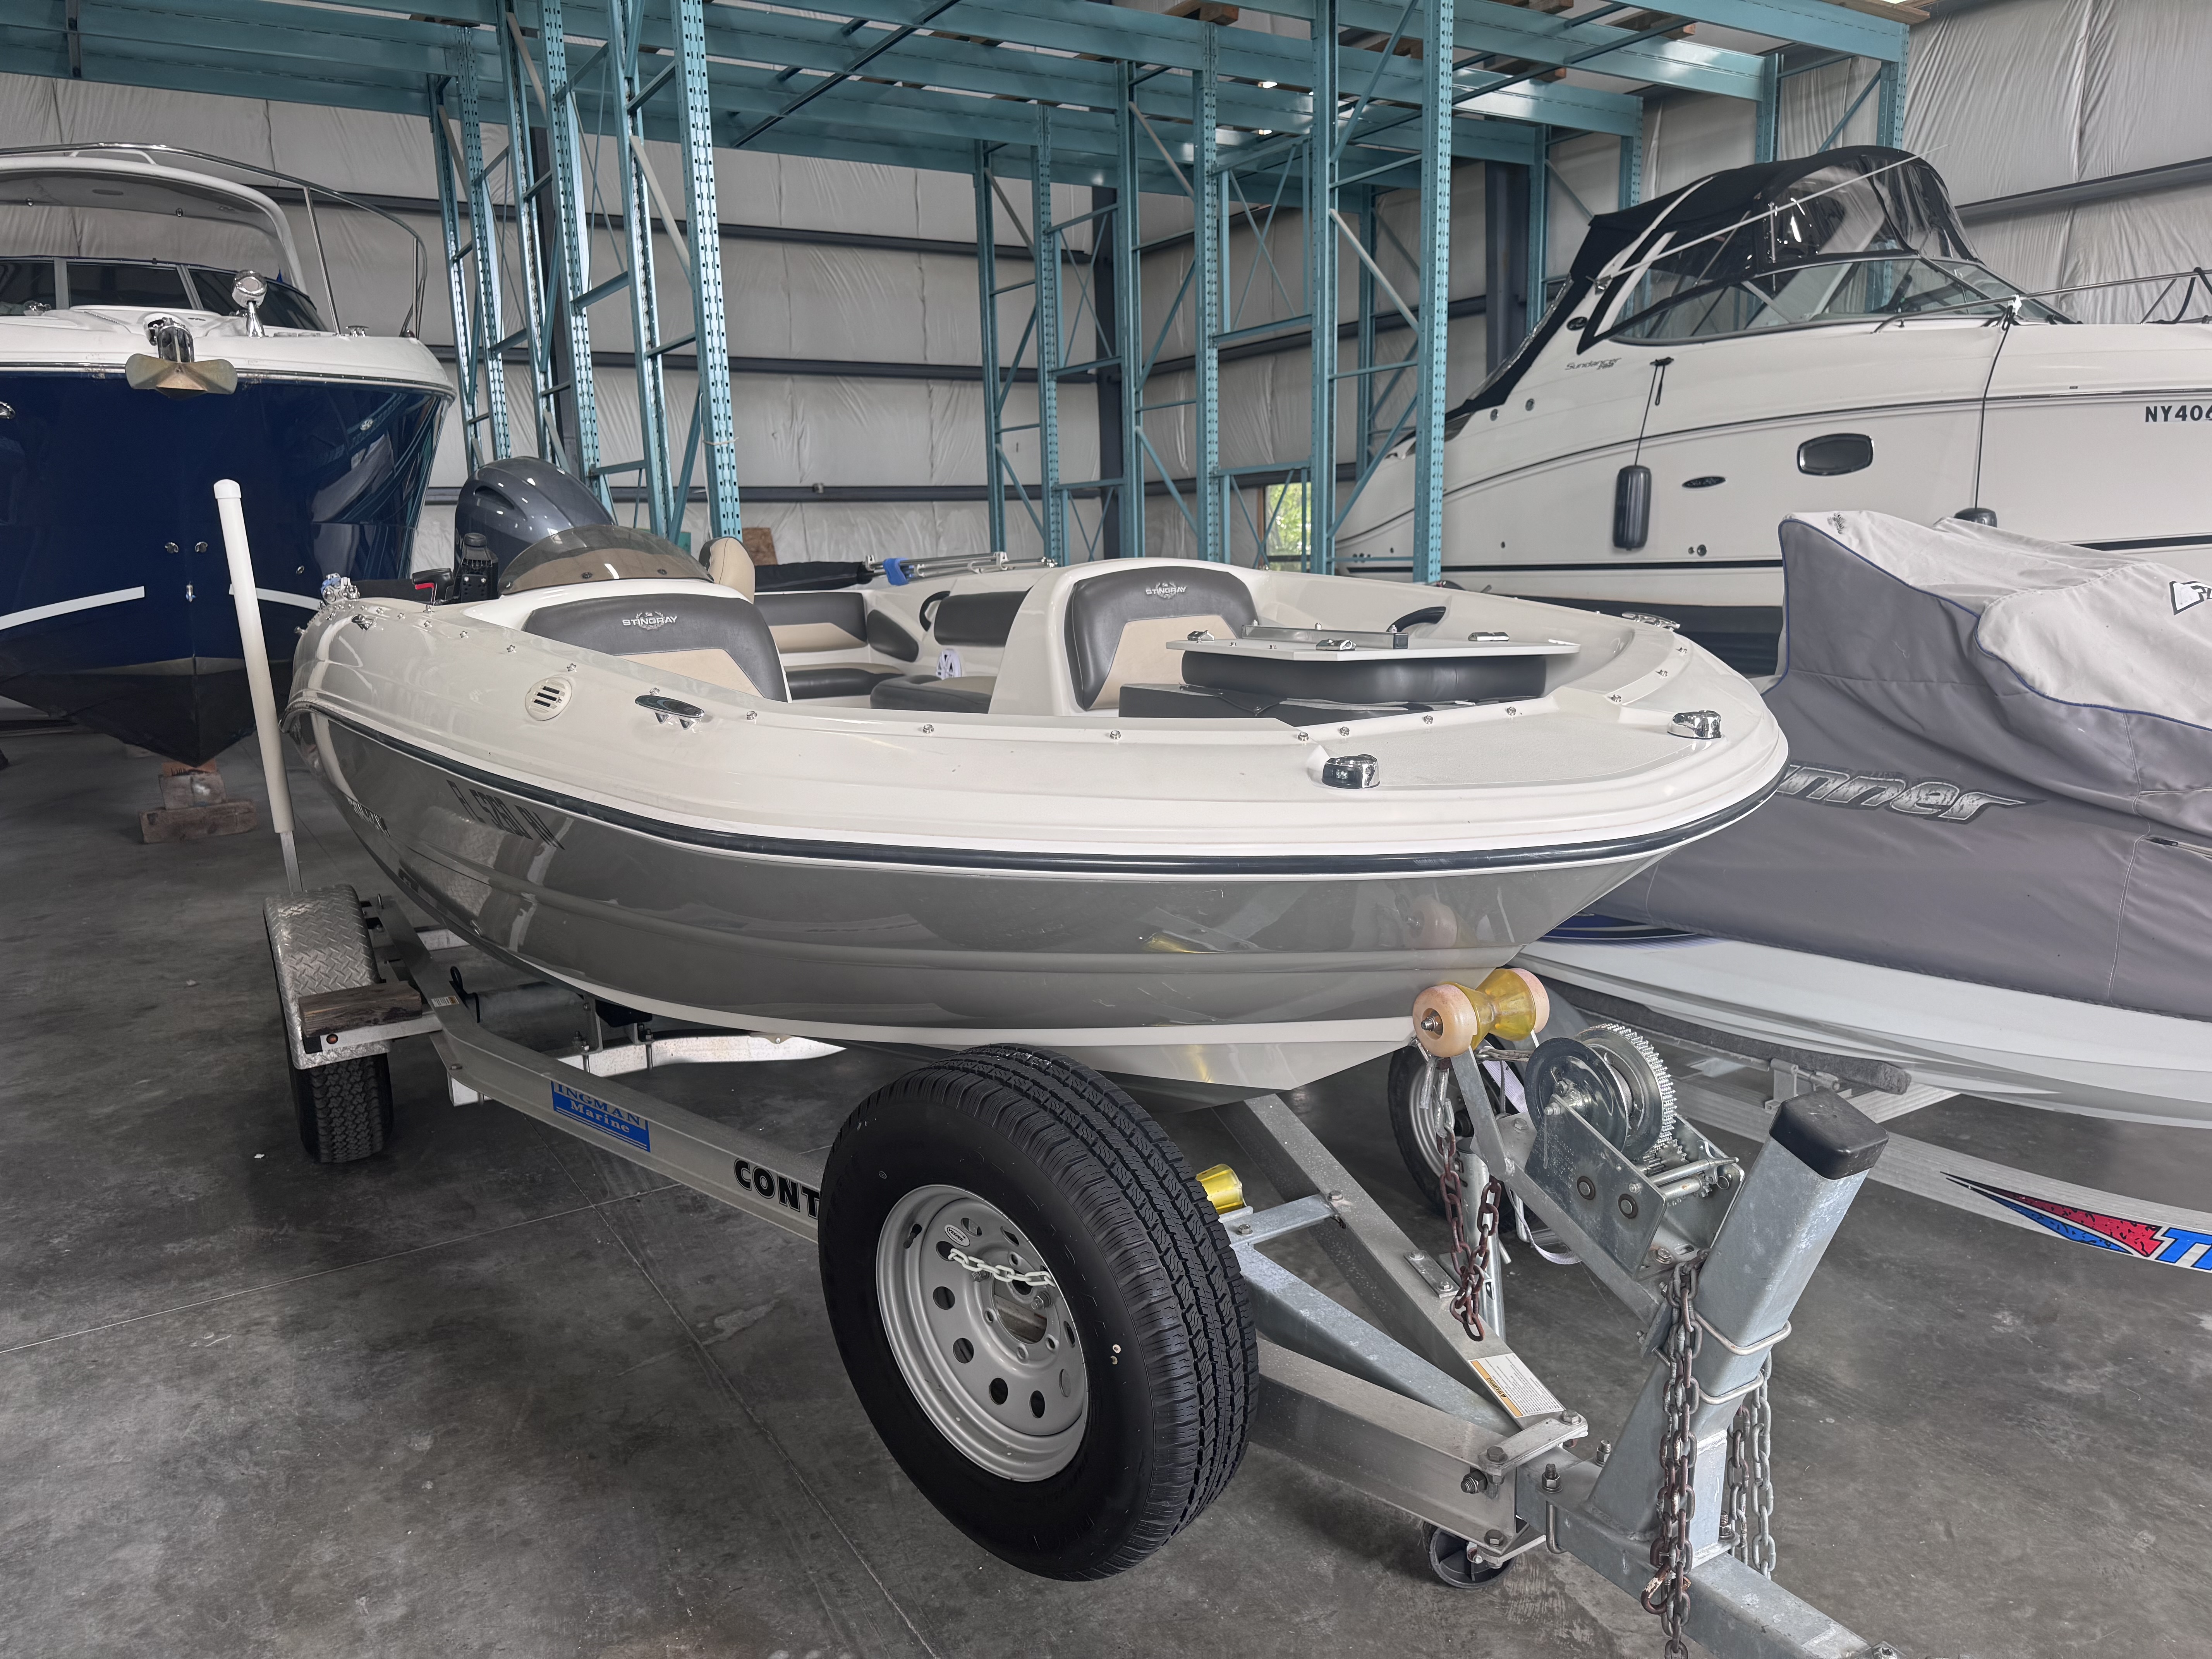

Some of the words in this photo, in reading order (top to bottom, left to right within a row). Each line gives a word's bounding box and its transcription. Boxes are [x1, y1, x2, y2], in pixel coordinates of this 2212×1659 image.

[1145, 587, 1187, 595] STINGRAY
[622, 616, 678, 626] STINGRAY
[446, 779, 486, 824] FL
[469, 788, 533, 840] 5260
[557, 1084, 641, 1126] INGMAN
[570, 1099, 630, 1133] Marine
[948, 1228, 964, 1242] VESPER
[1486, 1377, 1503, 1398] WARNING
